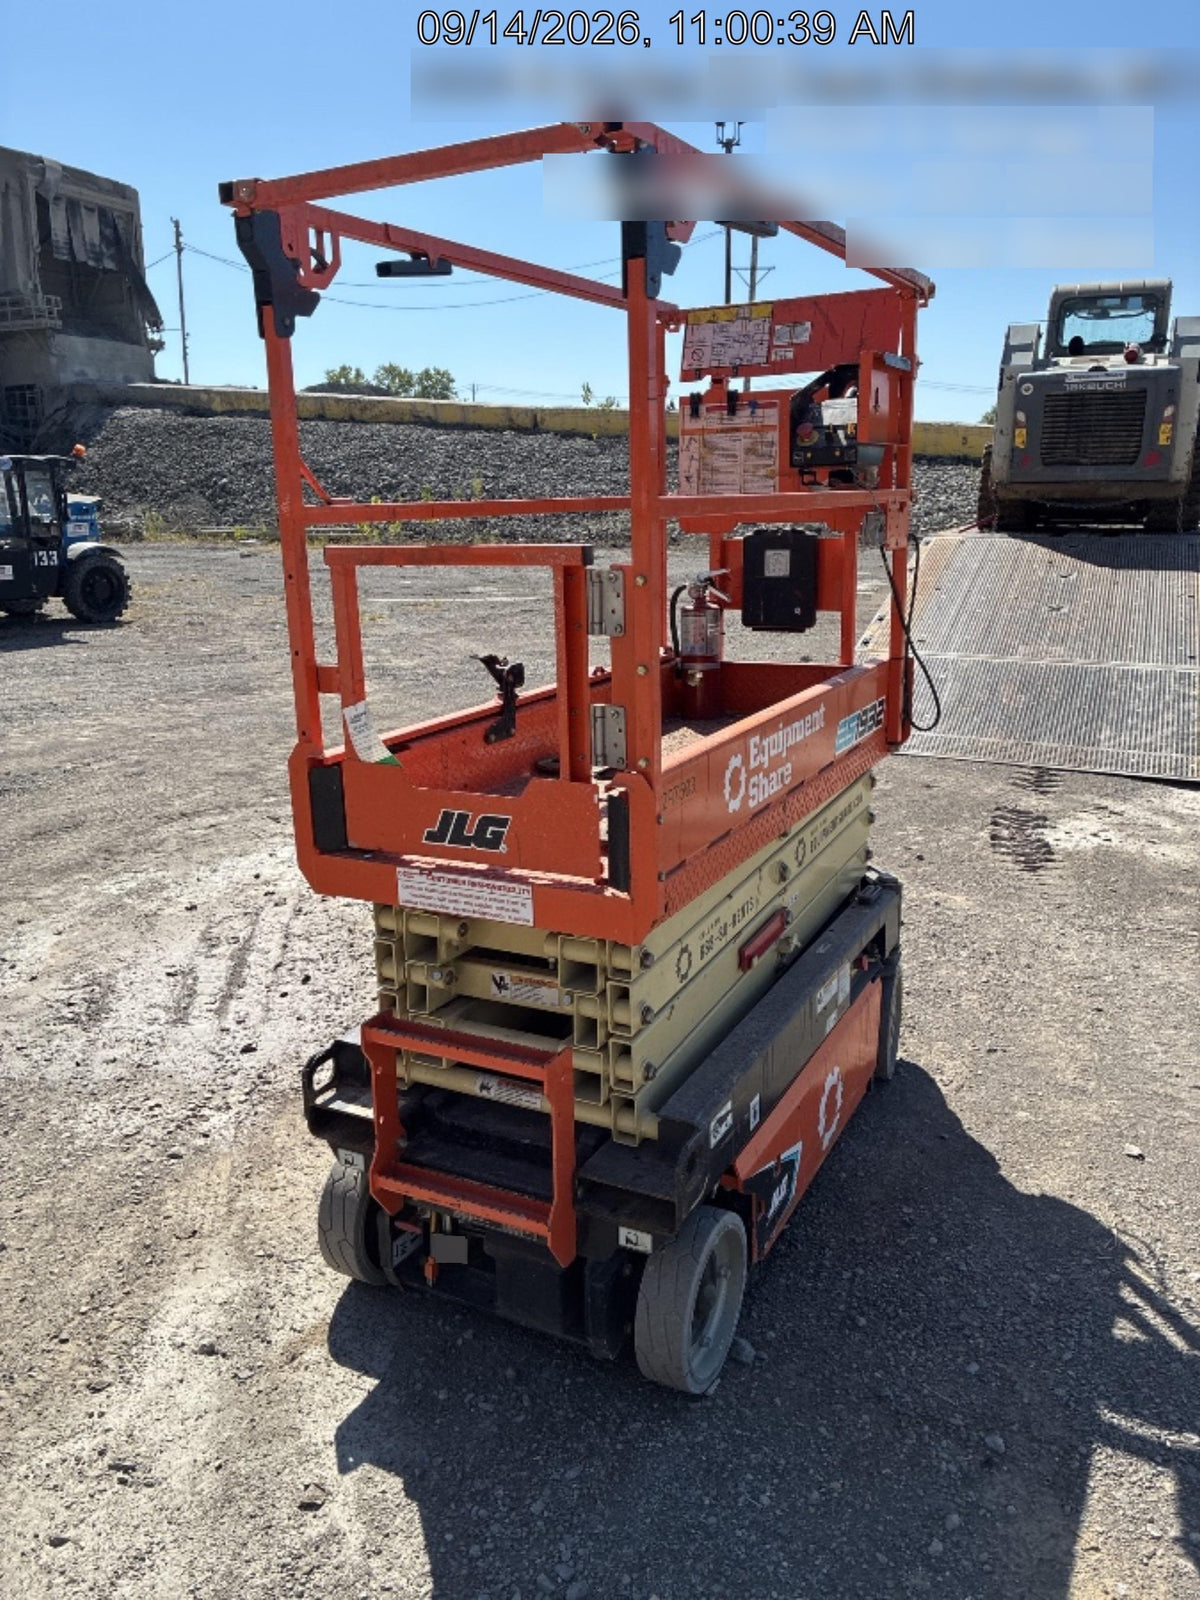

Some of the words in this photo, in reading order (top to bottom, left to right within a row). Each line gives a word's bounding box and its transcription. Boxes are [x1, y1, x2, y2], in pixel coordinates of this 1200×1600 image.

[34, 550, 58, 567] 133
[749, 702, 826, 769] Equipment
[748, 762, 792, 808] Share
[421, 808, 513, 853] JLG
